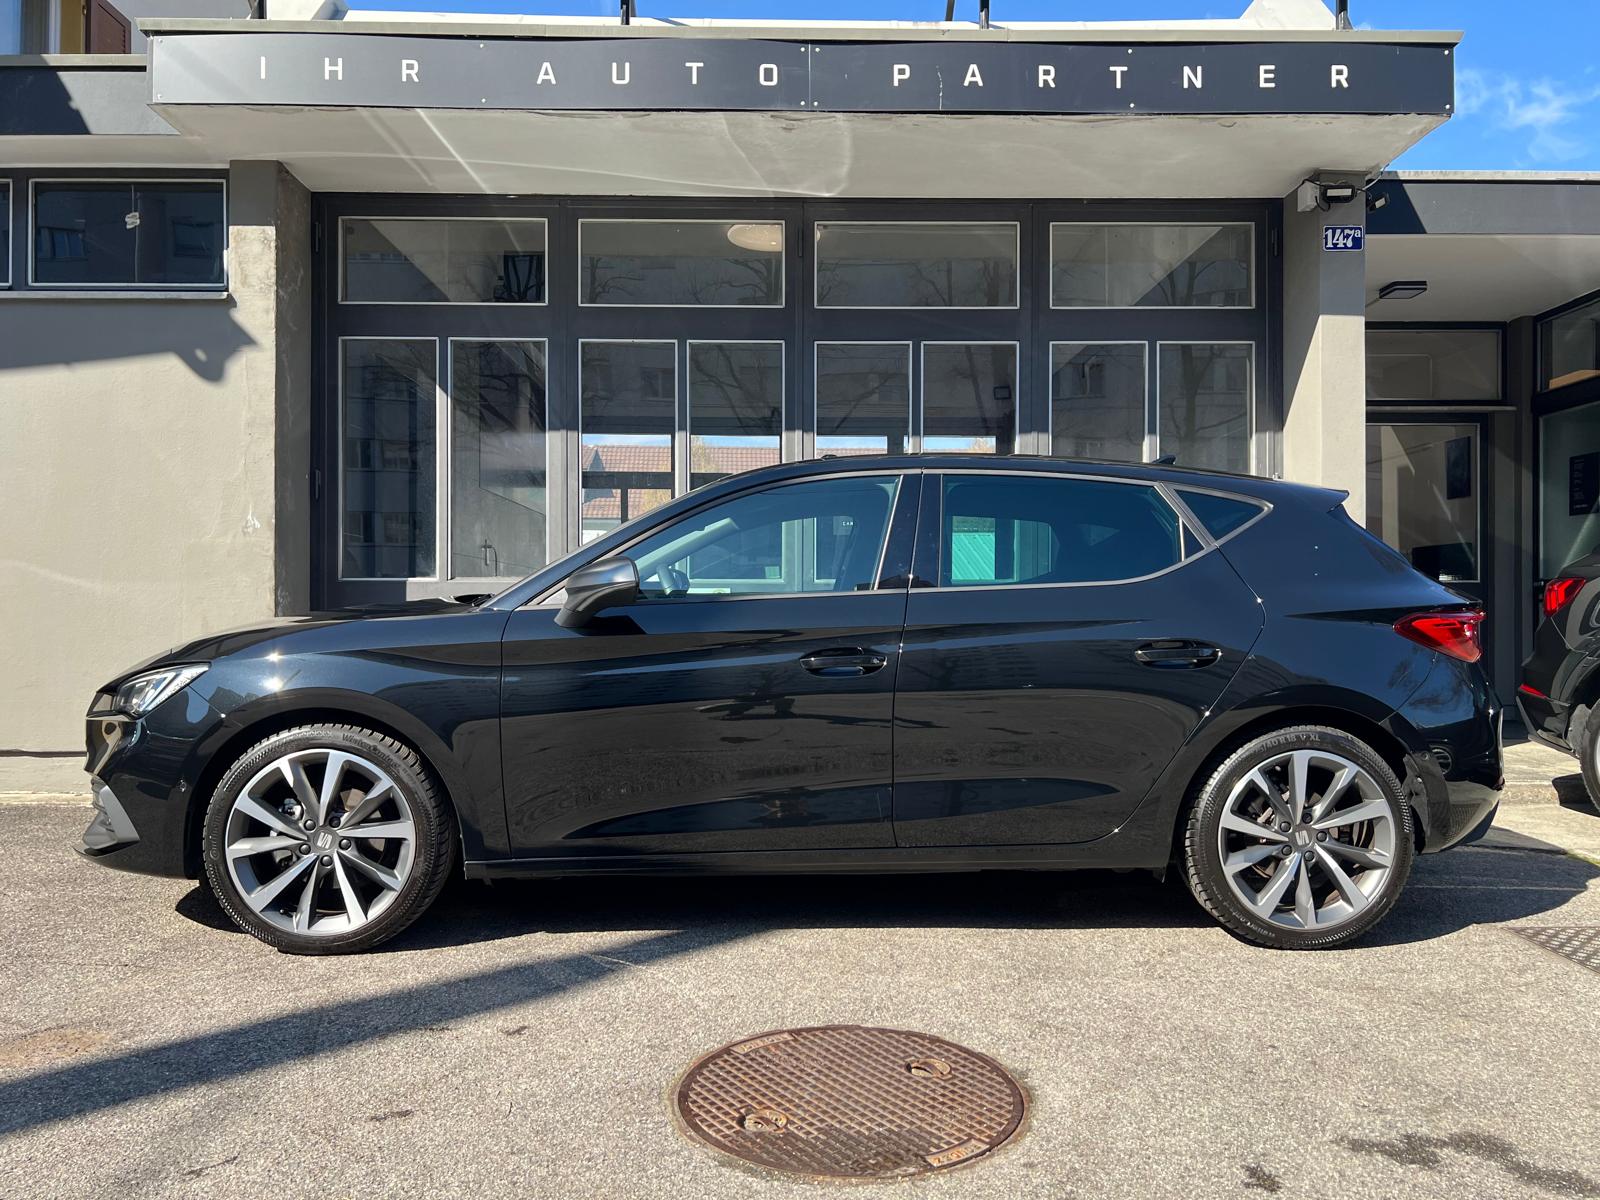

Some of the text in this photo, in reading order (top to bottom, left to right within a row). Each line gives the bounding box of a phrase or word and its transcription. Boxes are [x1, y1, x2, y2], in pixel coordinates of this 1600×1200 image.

[260, 56, 1350, 89] IHR AUTO PARTNER
[1325, 229, 1361, 247] 147a
